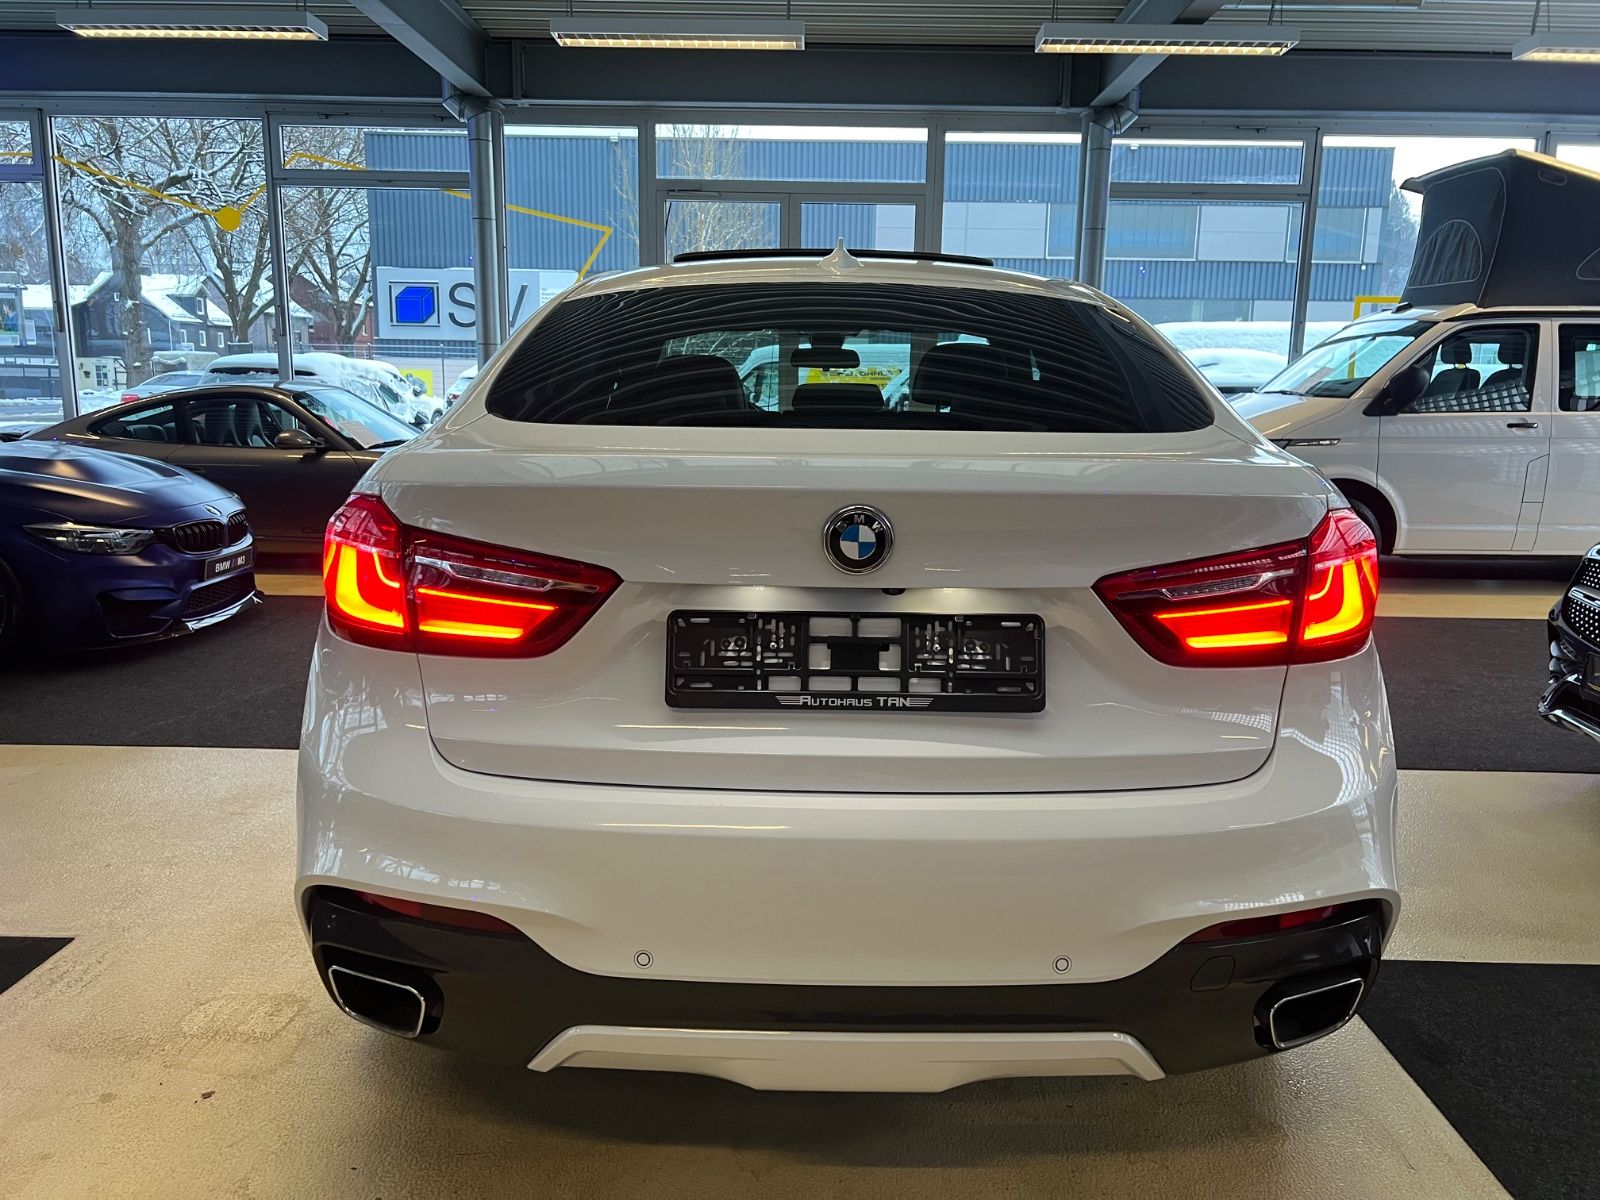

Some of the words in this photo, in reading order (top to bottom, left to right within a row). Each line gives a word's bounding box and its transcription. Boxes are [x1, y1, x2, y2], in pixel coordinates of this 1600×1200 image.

[835, 514, 883, 533] BMW
[215, 560, 231, 573] BMW
[237, 555, 246, 566] M3
[800, 695, 873, 707] AUTOHAUS
[876, 696, 911, 707] TAN
